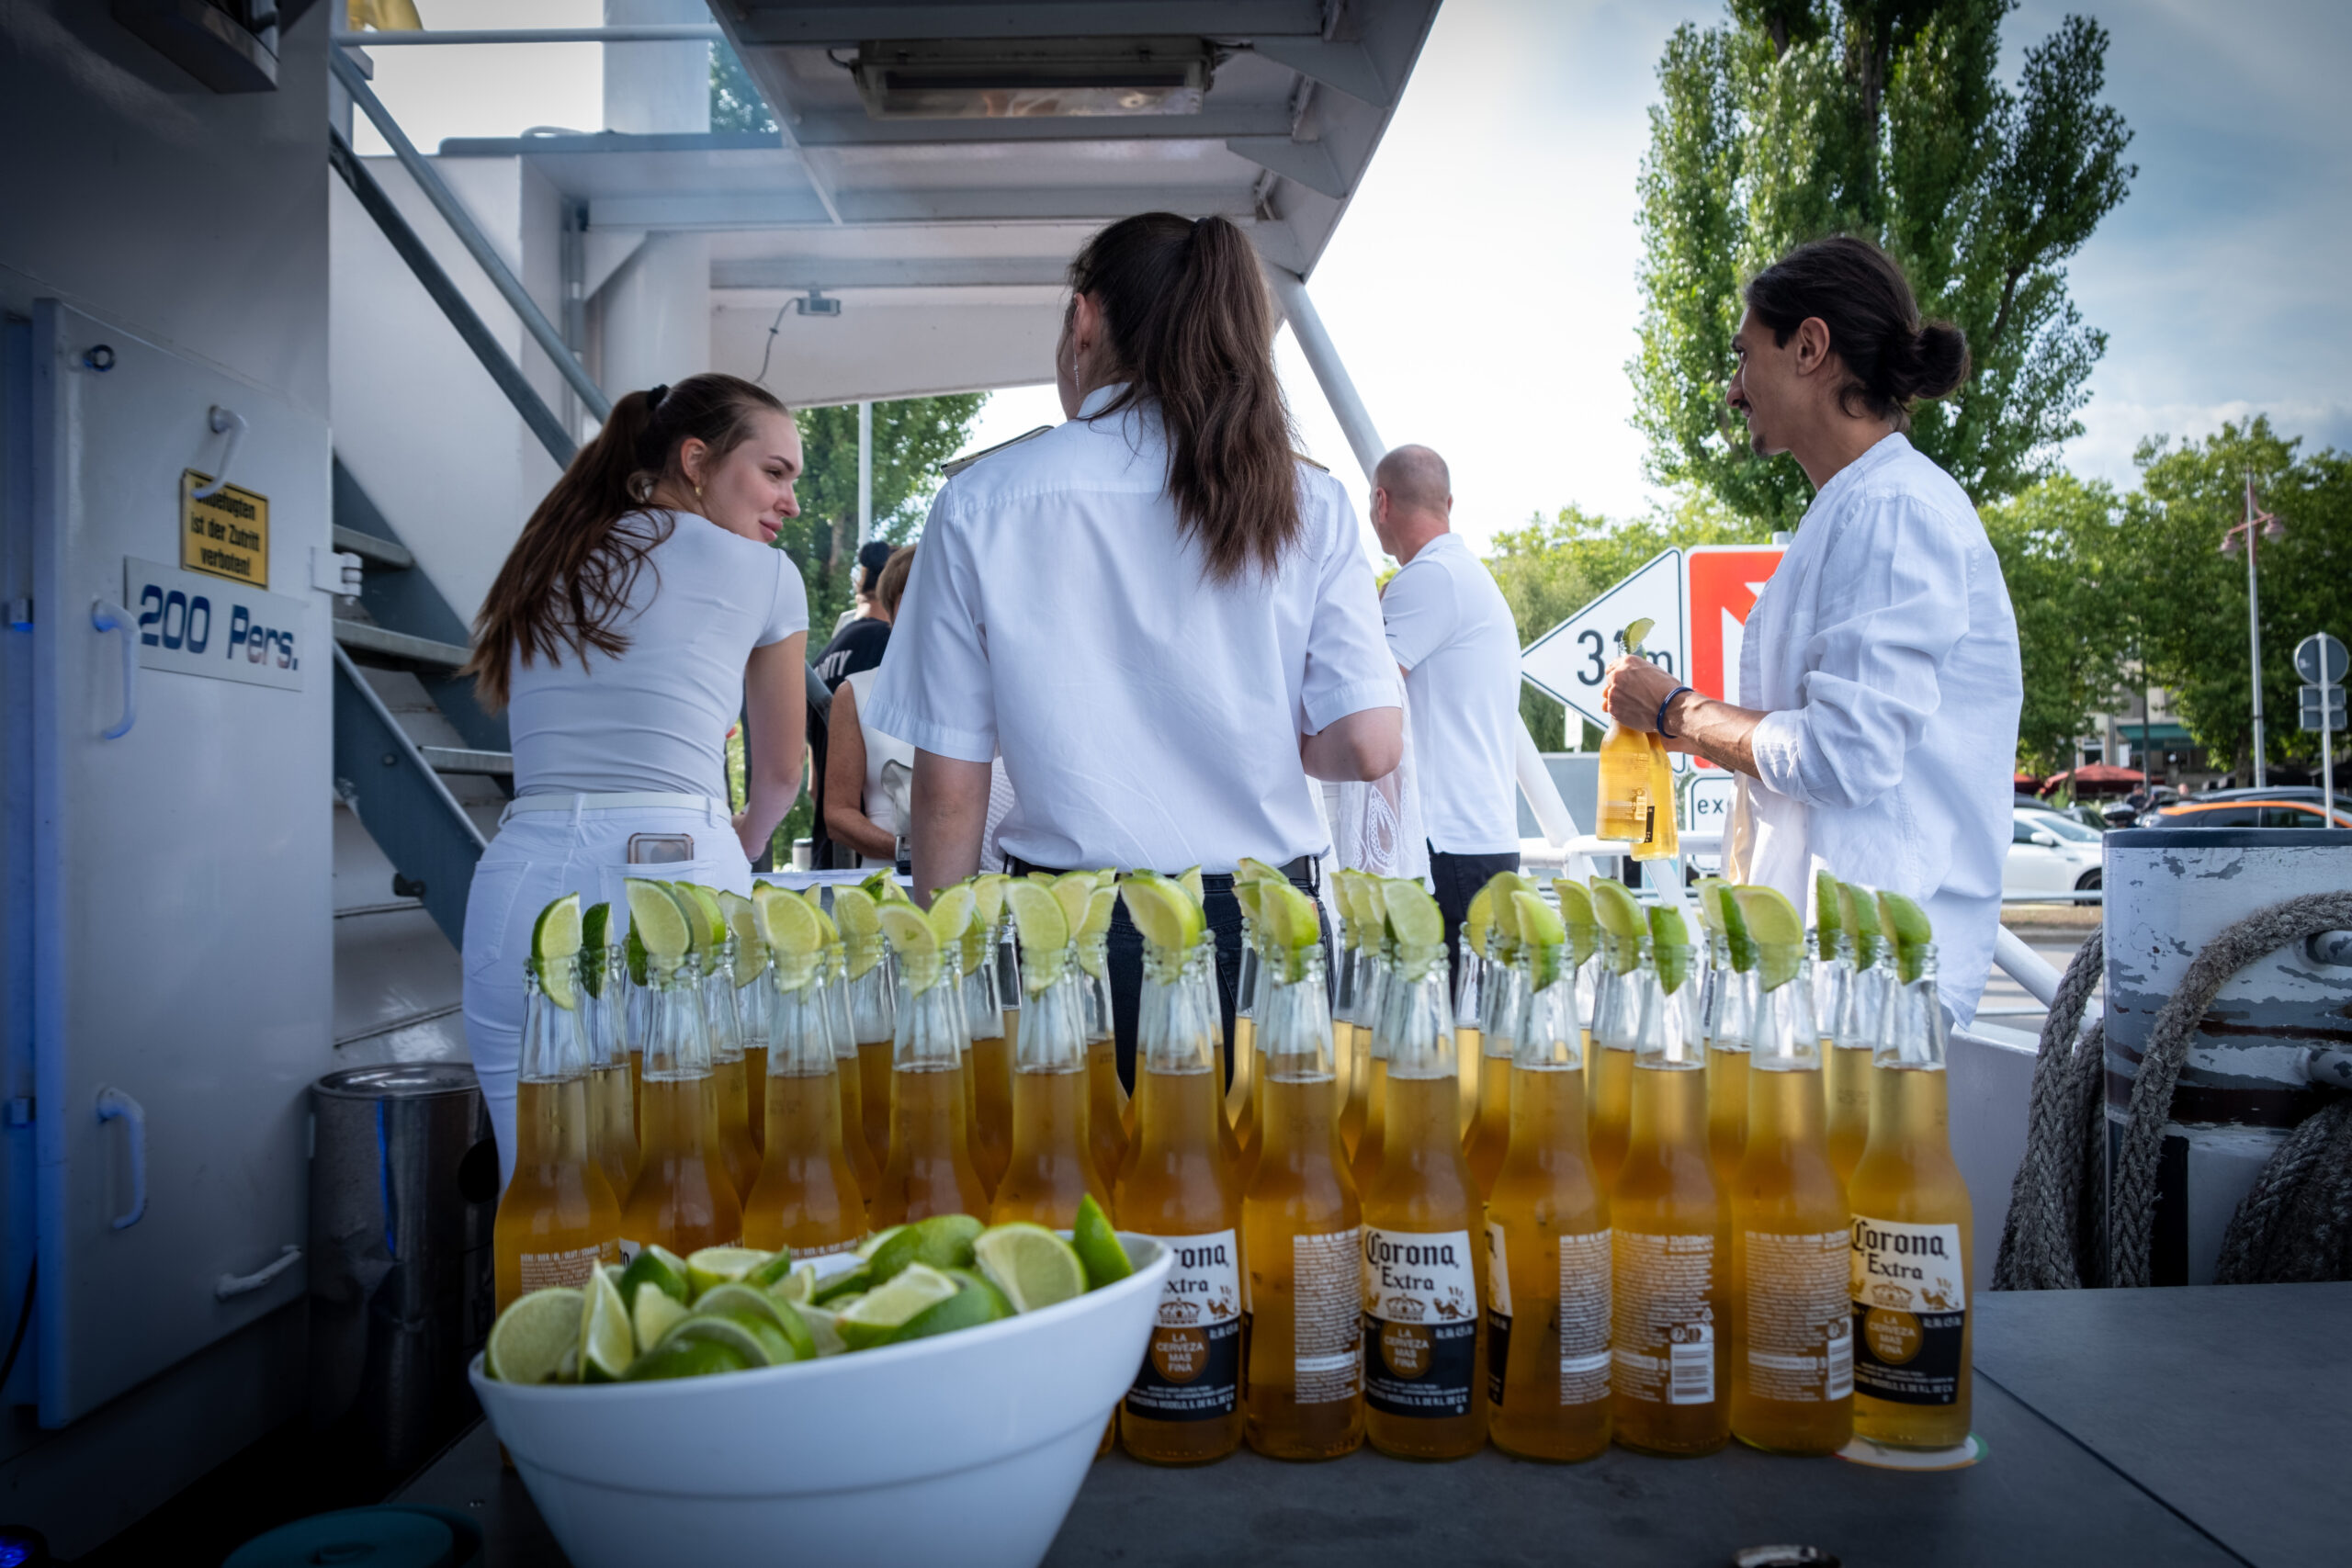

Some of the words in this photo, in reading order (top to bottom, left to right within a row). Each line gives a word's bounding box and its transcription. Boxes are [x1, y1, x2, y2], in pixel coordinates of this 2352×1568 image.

[191, 512, 204, 535] ist
[208, 519, 226, 541] der
[228, 523, 260, 552] Zutritt
[200, 547, 251, 576] verboten!
[139, 584, 210, 654] 200
[227, 604, 299, 671] Pers.
[1851, 1219, 1949, 1259] Corona
[1174, 1245, 1230, 1269] ona
[1365, 1231, 1459, 1269] Corona
[1868, 1254, 1924, 1280] Extra
[1164, 1278, 1209, 1294] xtra
[1382, 1266, 1435, 1291] Extra
[1883, 1315, 1898, 1325] LA
[1397, 1327, 1412, 1337] LA
[1868, 1321, 1917, 1337] CERVEZA
[1171, 1333, 1187, 1343] LA
[1384, 1335, 1430, 1349] CERVEZA
[1155, 1341, 1204, 1352] CERVEZA
[1879, 1343, 1904, 1355] FINA
[1168, 1362, 1193, 1372] FINA
[1394, 1357, 1419, 1368] FINA
